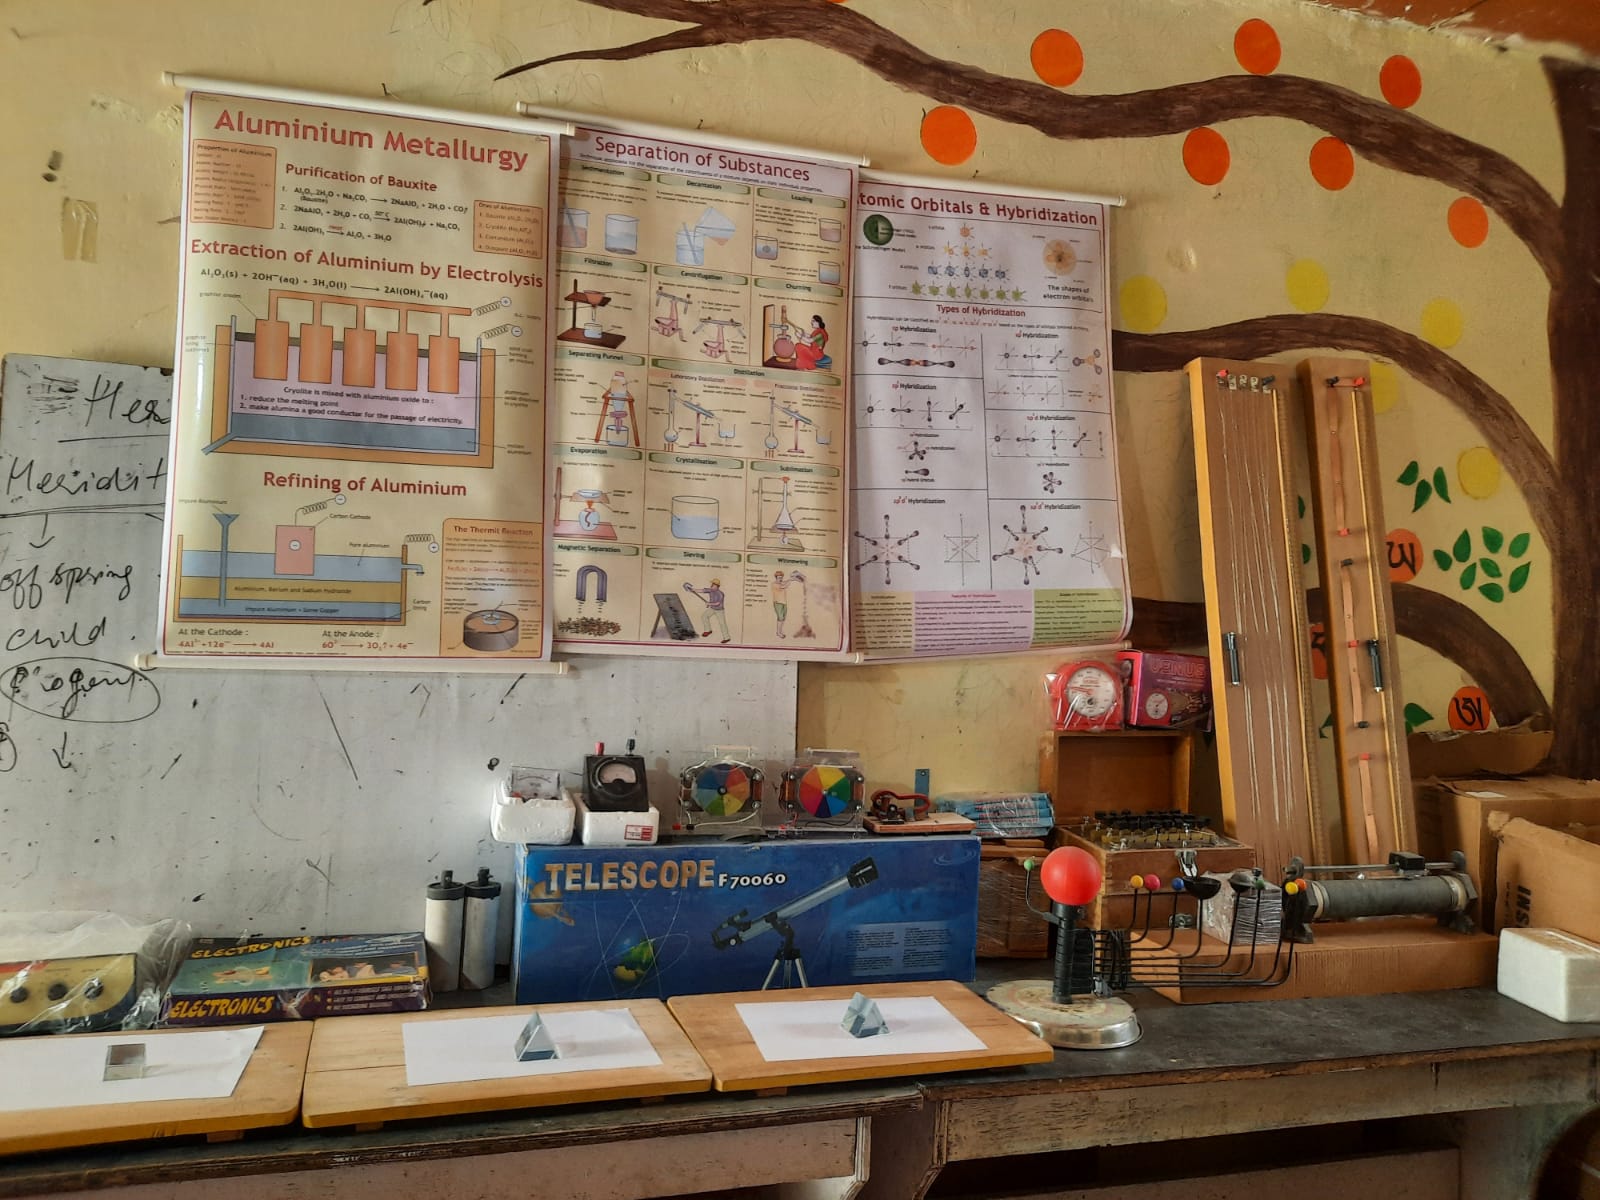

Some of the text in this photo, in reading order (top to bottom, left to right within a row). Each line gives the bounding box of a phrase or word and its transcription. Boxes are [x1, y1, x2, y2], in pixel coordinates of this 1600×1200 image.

[214, 109, 528, 172] Aluminium Metallurgy
[596, 136, 810, 181] Separation of Substances
[286, 164, 438, 192] Purification of Bauxite
[686, 180, 722, 190] Decantation
[857, 193, 1097, 225] tomic Orbitals & Hybridization
[192, 240, 287, 261] Extraction
[294, 250, 313, 264] of
[317, 252, 414, 275] Aluminium
[421, 262, 441, 279] by
[448, 264, 543, 288] Electrolysis
[936, 304, 1026, 317] Types of Hybridization
[568, 350, 601, 360] Separating
[250, 395, 275, 403] reduce
[277, 396, 290, 404] the
[292, 398, 318, 408] melting
[320, 400, 339, 408] point
[284, 387, 312, 396] Cryolite
[364, 393, 399, 402] aluminium
[250, 404, 269, 412] make
[271, 405, 299, 413] alumina
[308, 407, 325, 416] good
[327, 409, 362, 418] conductor
[377, 412, 389, 420] the
[390, 414, 416, 423] passage
[570, 446, 608, 456] Evaporation
[264, 472, 467, 496] Refining of Aluminium
[178, 628, 243, 636] At the Cathode
[322, 630, 374, 638] At the Anode
[545, 860, 716, 892] TELESCOPE
[192, 936, 312, 959] ELECTRONICS
[170, 996, 276, 1019] ELECTRONICS
